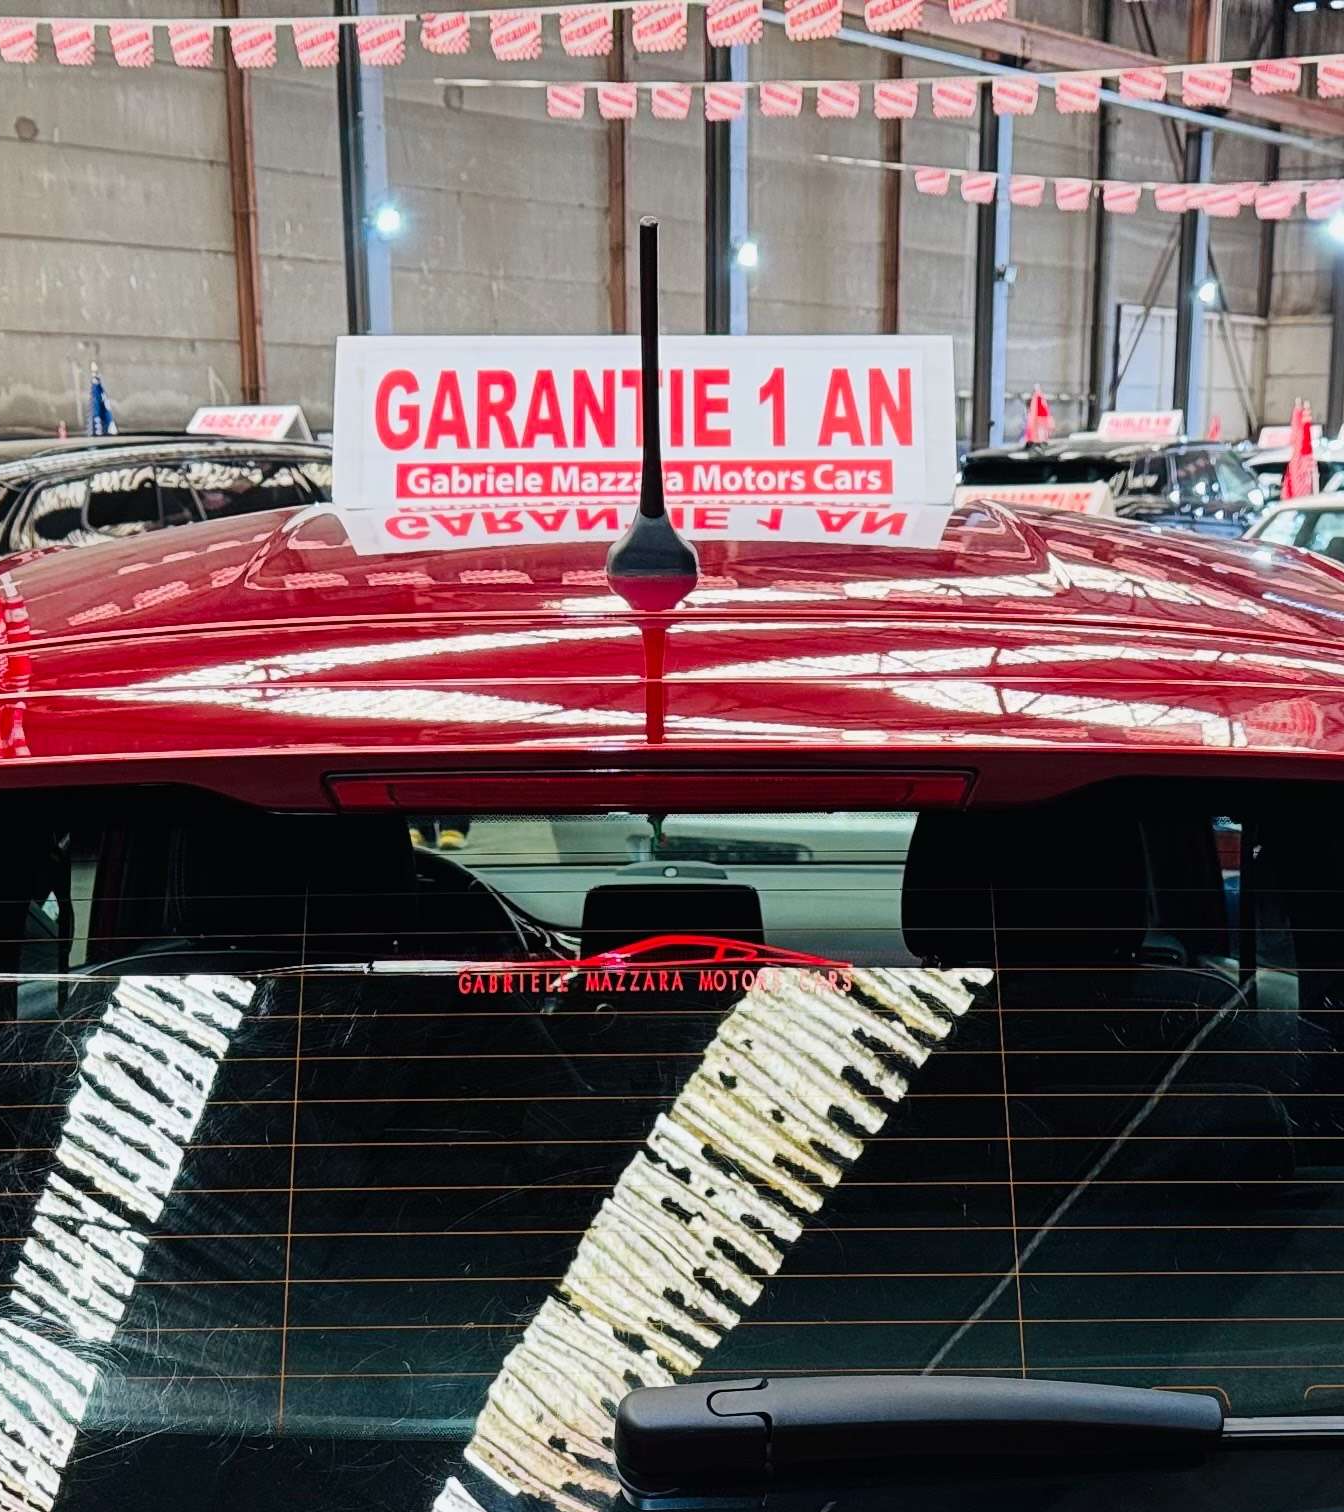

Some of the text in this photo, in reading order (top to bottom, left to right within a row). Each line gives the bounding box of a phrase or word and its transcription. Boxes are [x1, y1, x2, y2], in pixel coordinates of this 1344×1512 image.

[374, 367, 913, 450] GARANTIE 1 AN
[407, 462, 882, 495] Gabriele Mazza Motors Cars
[458, 968, 853, 994] GABRIELE MAZZARA MOTORS CARS
